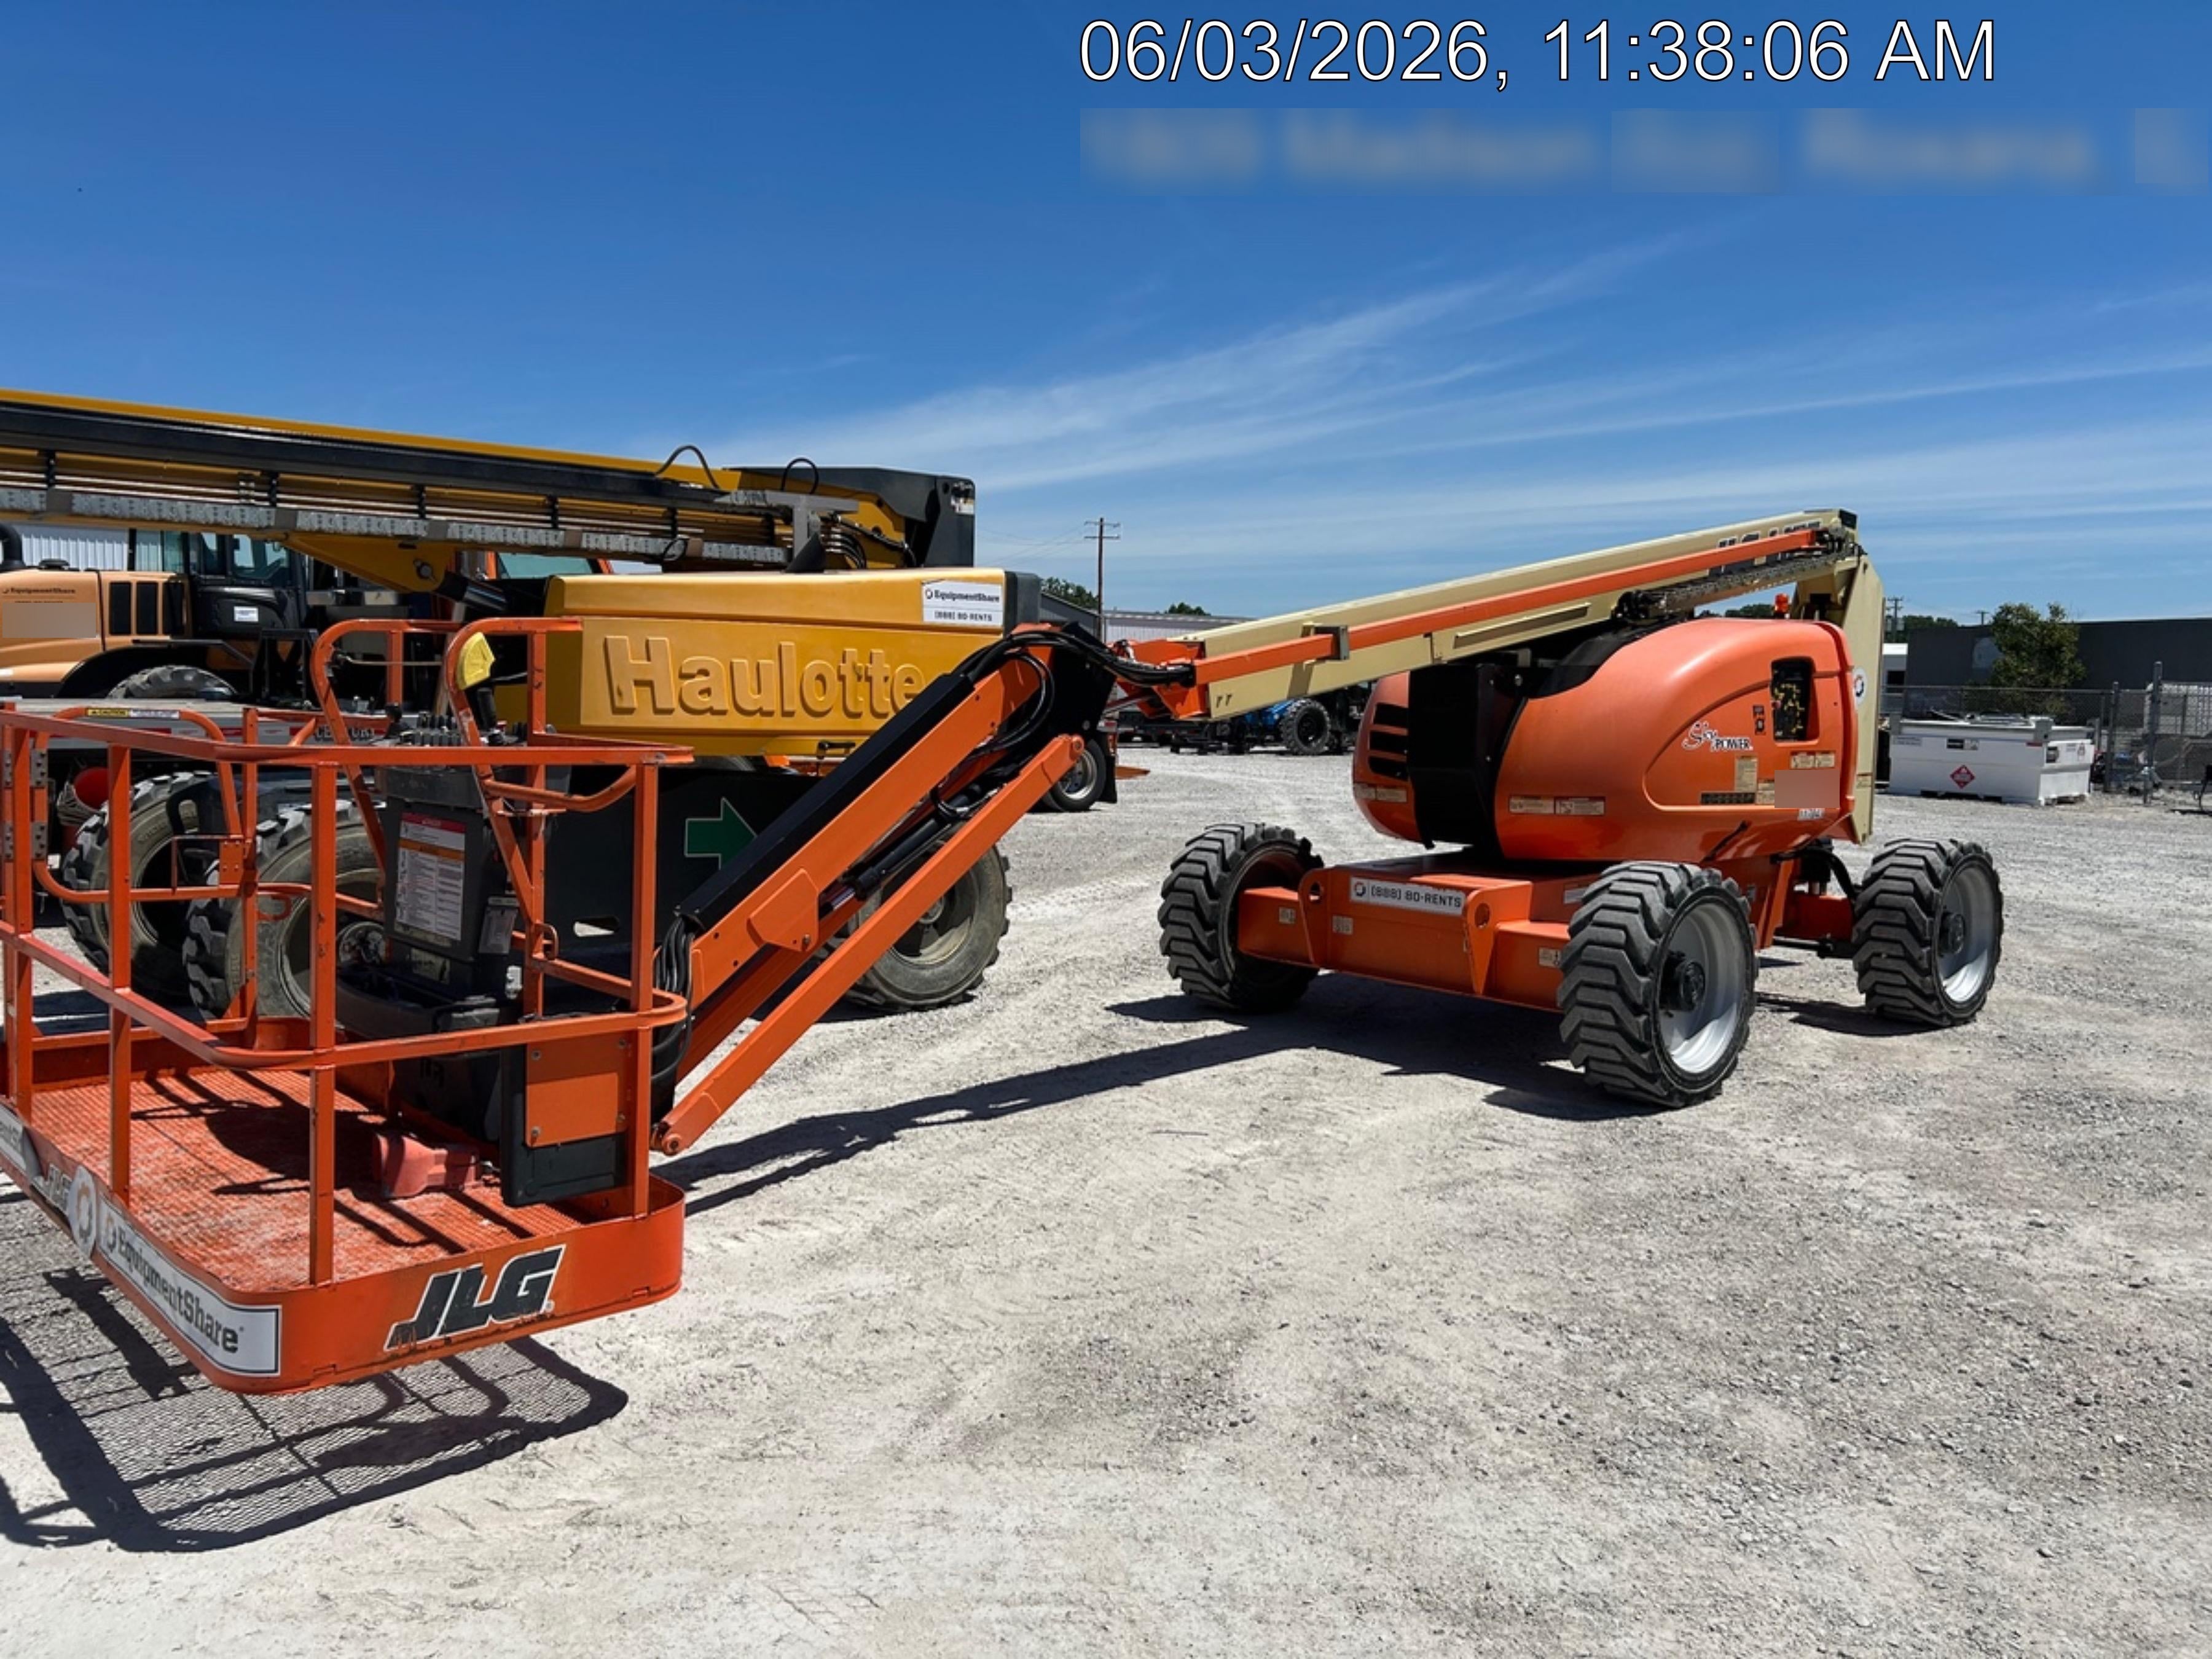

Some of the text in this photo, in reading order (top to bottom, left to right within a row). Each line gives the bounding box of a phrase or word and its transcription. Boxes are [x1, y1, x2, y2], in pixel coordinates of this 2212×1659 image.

[605, 637, 925, 718] Haulotte
[118, 1227, 240, 1354] EquipmentShare
[384, 1244, 567, 1352] JLG
